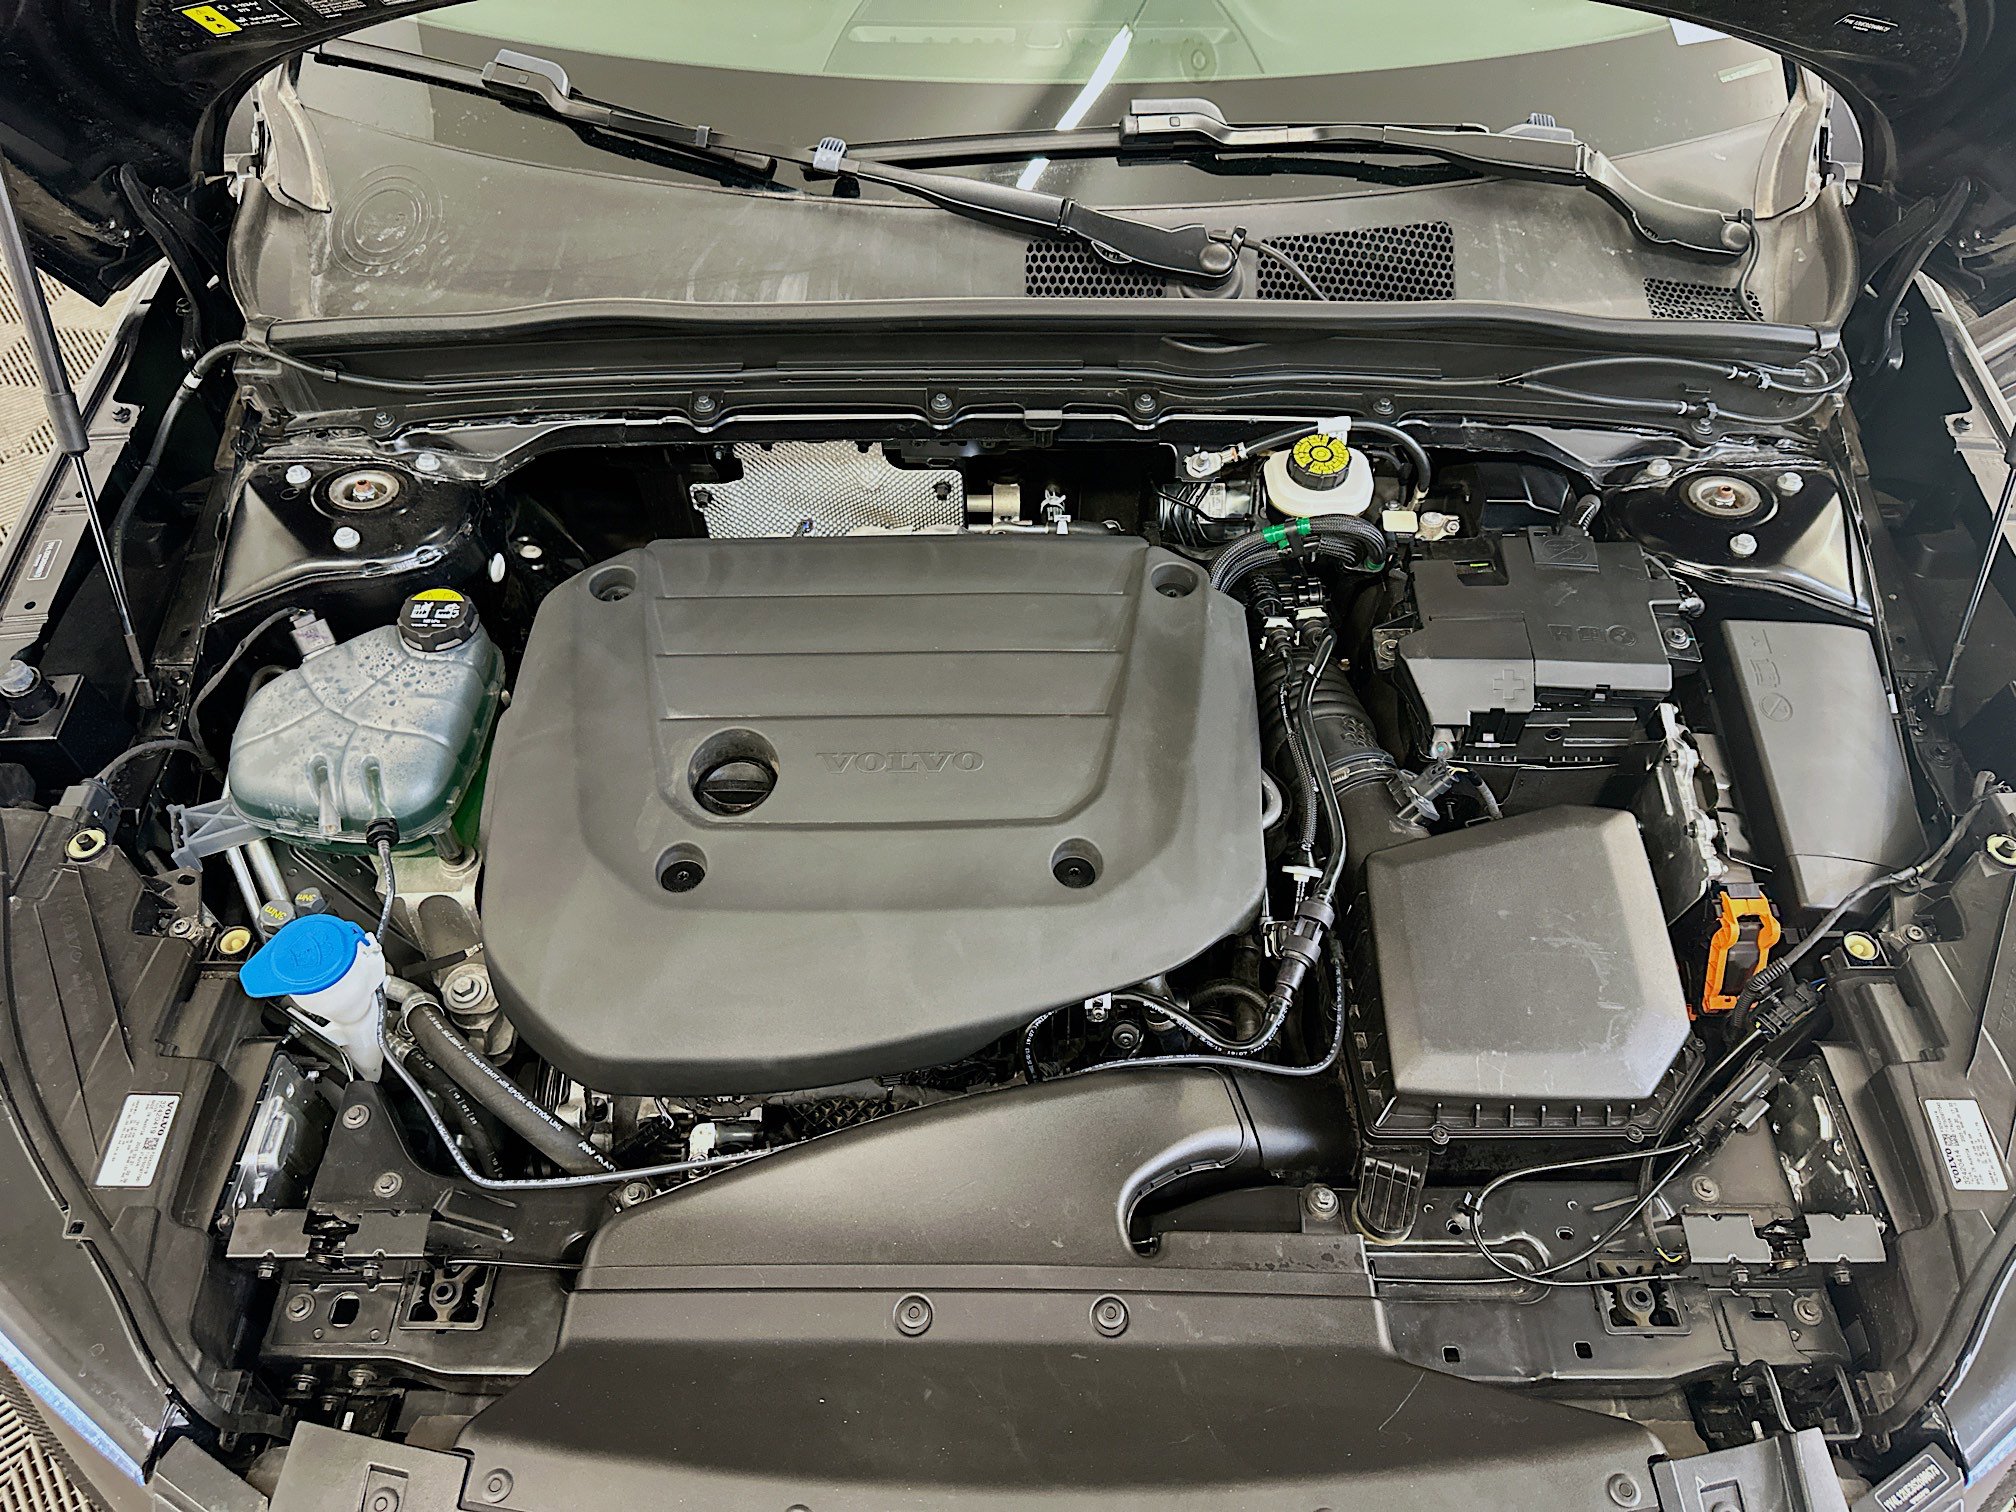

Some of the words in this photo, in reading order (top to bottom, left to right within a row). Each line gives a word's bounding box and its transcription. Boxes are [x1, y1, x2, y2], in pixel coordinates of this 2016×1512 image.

[815, 750, 985, 774] VOLVO
[264, 905, 288, 921] 3Nm
[157, 1100, 175, 1136] VOLVO
[525, 1100, 551, 1122] SUCTION
[548, 1117, 564, 1132] LINE
[1944, 1147, 1962, 1184] VOLVO
